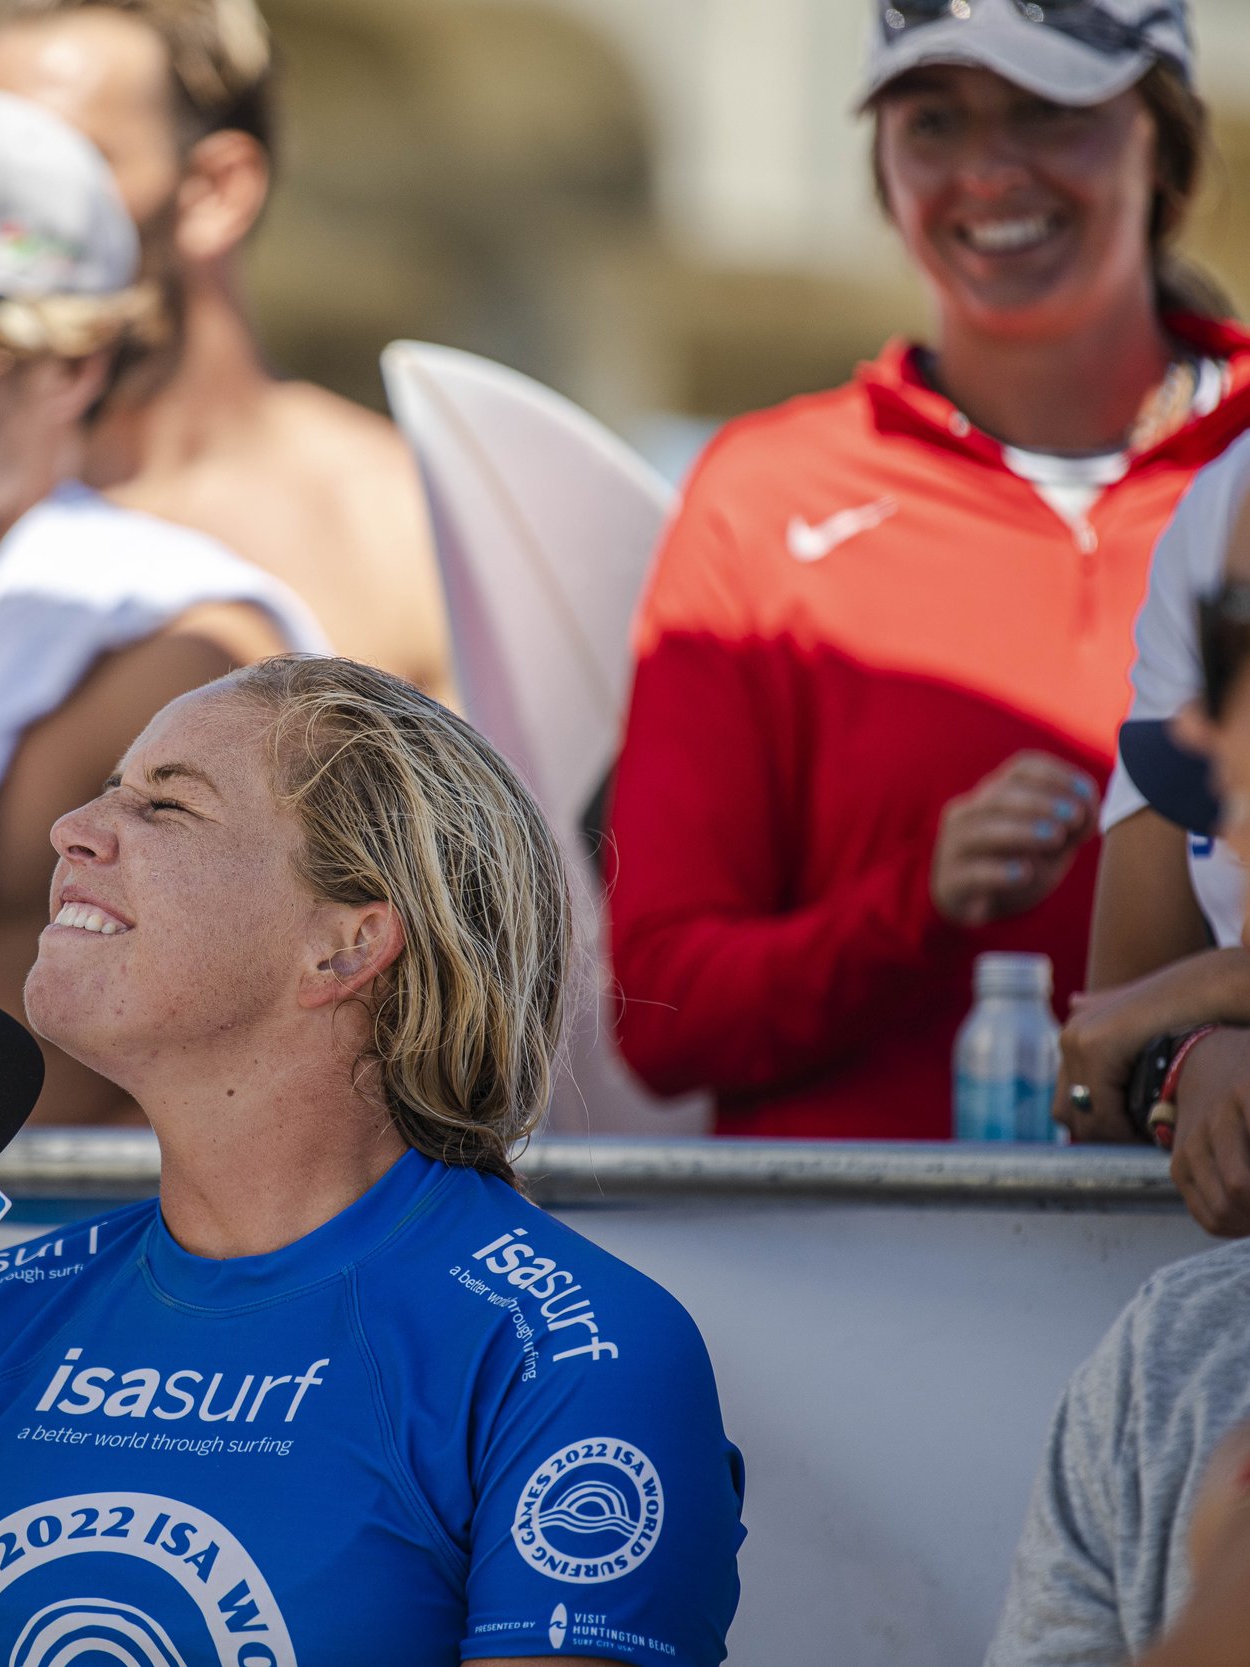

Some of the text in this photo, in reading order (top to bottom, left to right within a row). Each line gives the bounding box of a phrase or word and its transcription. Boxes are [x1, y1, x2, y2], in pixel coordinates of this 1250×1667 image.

[450, 1266, 461, 1276] a
[458, 1270, 490, 1295] better
[472, 1228, 618, 1361] isasurf
[35, 1348, 330, 1422] isasurf
[17, 1425, 294, 1456] a better world through surfing
[518, 1443, 659, 1577] 2022 ISA WORLD SURFING GAMES
[143, 1513, 220, 1584] ISA
[475, 1621, 536, 1634] PRESENTED BY
[574, 1613, 607, 1624] VISIT
[573, 1626, 676, 1656] HUNTINGTON BEACH
[573, 1638, 593, 1646] SURF
[596, 1640, 615, 1649] CITY
